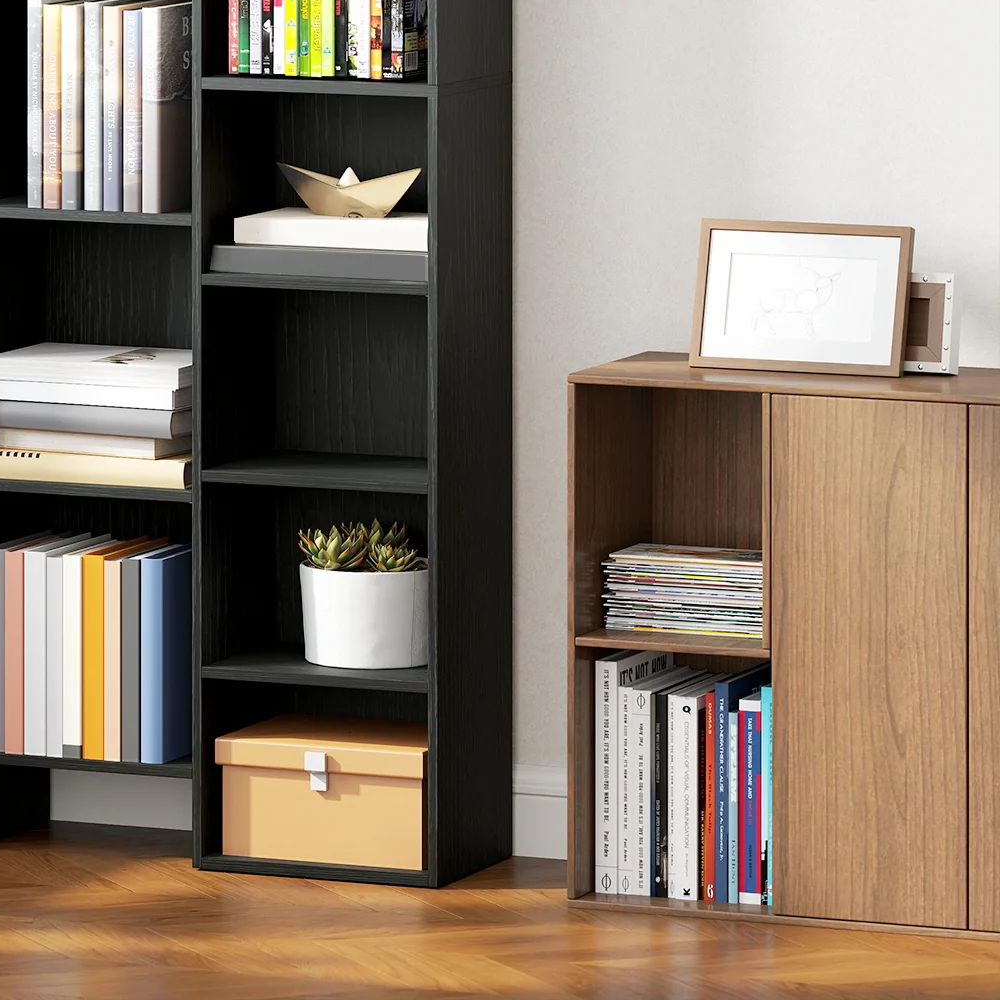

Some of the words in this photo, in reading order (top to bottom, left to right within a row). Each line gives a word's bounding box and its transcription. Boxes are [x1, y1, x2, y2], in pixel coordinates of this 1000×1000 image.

[128, 47, 136, 68] AND
[128, 70, 136, 100] STEVE
[128, 108, 136, 122] ON
[48, 112, 56, 146] ABOUT
[48, 149, 56, 170] YOU
[128, 125, 136, 176] VACATION
